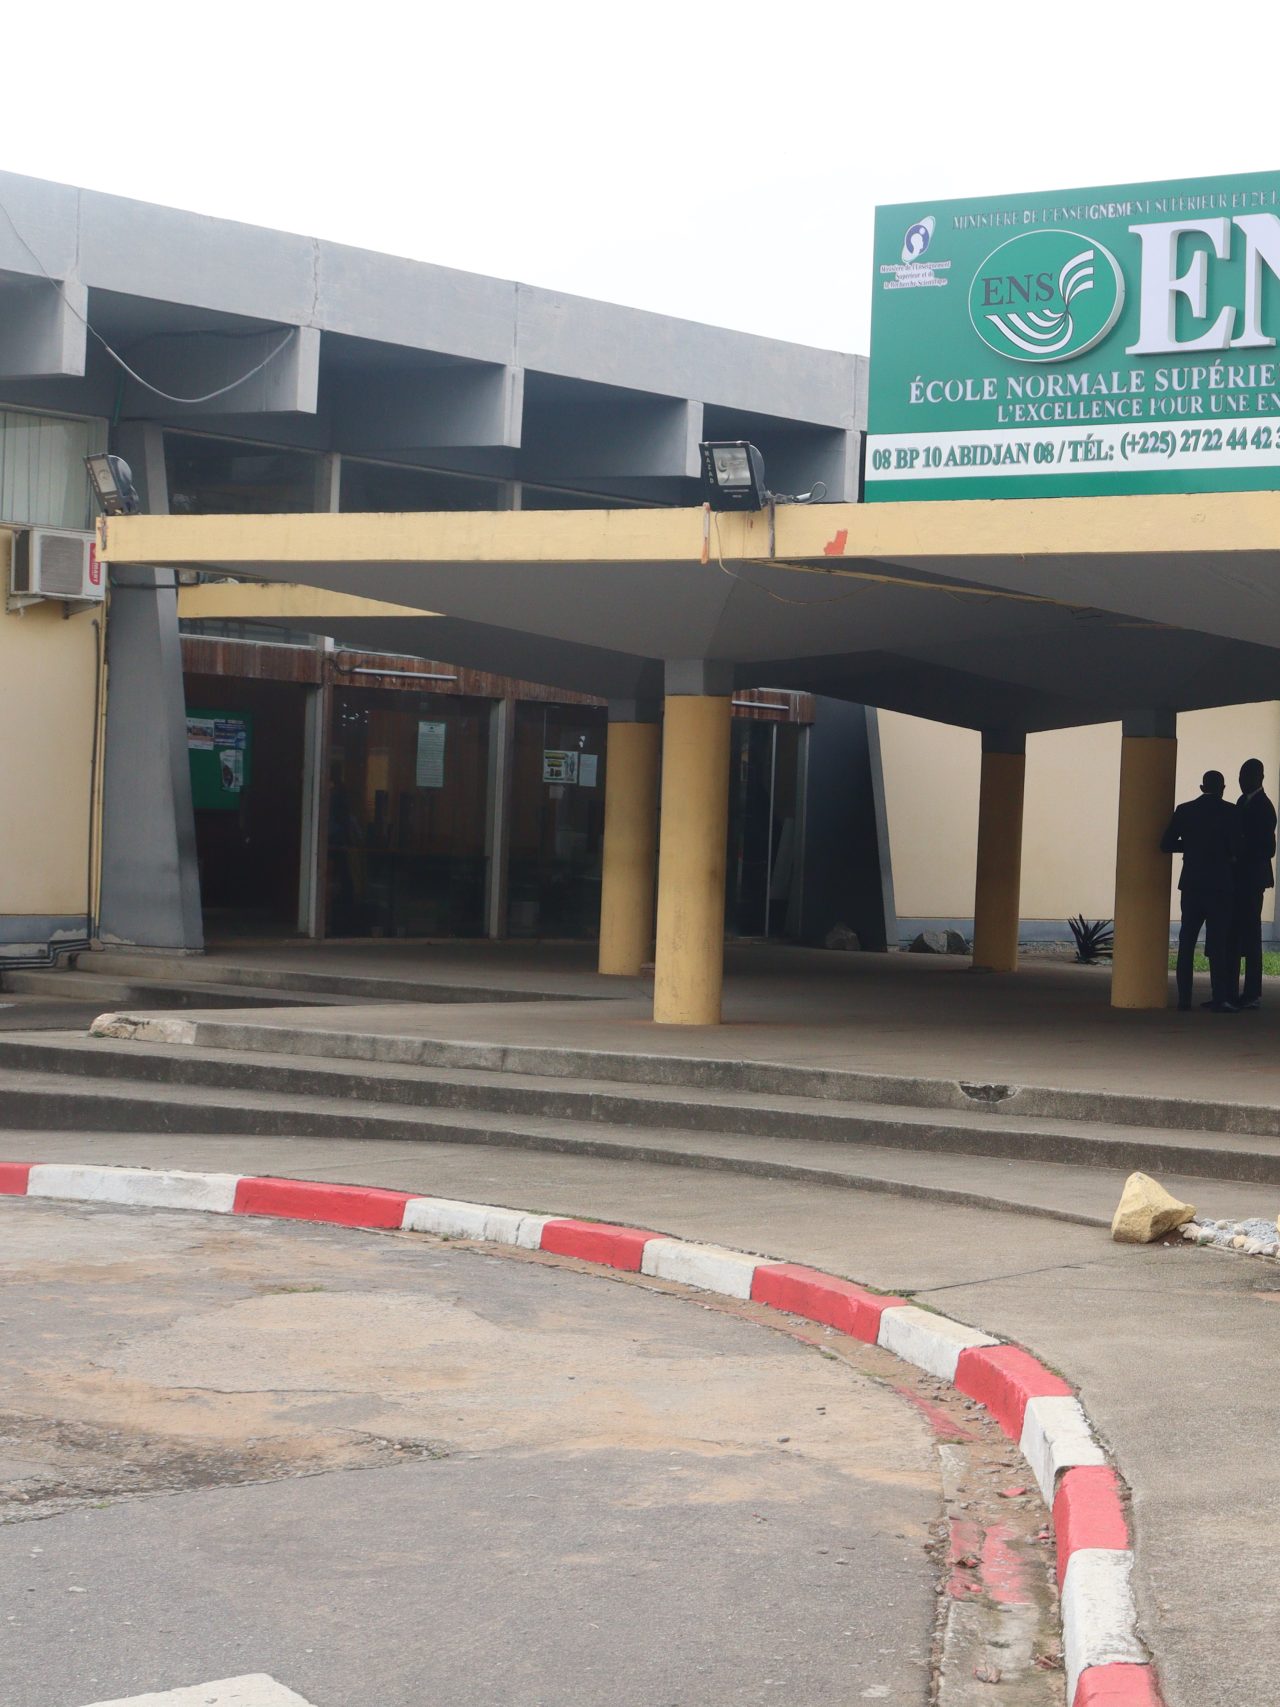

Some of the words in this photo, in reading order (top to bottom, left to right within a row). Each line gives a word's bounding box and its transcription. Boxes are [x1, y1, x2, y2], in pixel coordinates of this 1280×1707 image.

[1023, 209, 1037, 224] DE
[1042, 199, 1150, 223] L'ENSEIGNEMENT
[1232, 192, 1247, 208] ET
[1251, 191, 1265, 207] DE
[980, 272, 1054, 306] ENS
[909, 375, 997, 404] ÉCOLE
[1006, 370, 1146, 399] NORMALE
[997, 399, 1143, 423] L'EXCELLENCE
[1150, 395, 1203, 416] POUR
[1210, 394, 1250, 412] UNE
[872, 448, 892, 470] 08
[895, 447, 920, 470] BP
[922, 446, 942, 468] 10
[943, 442, 1030, 467] ABIDJAN
[1033, 441, 1055, 464] 08
[1120, 430, 1177, 461] (+225)
[1226, 426, 1248, 450] 44
[1250, 425, 1273, 450] 42
